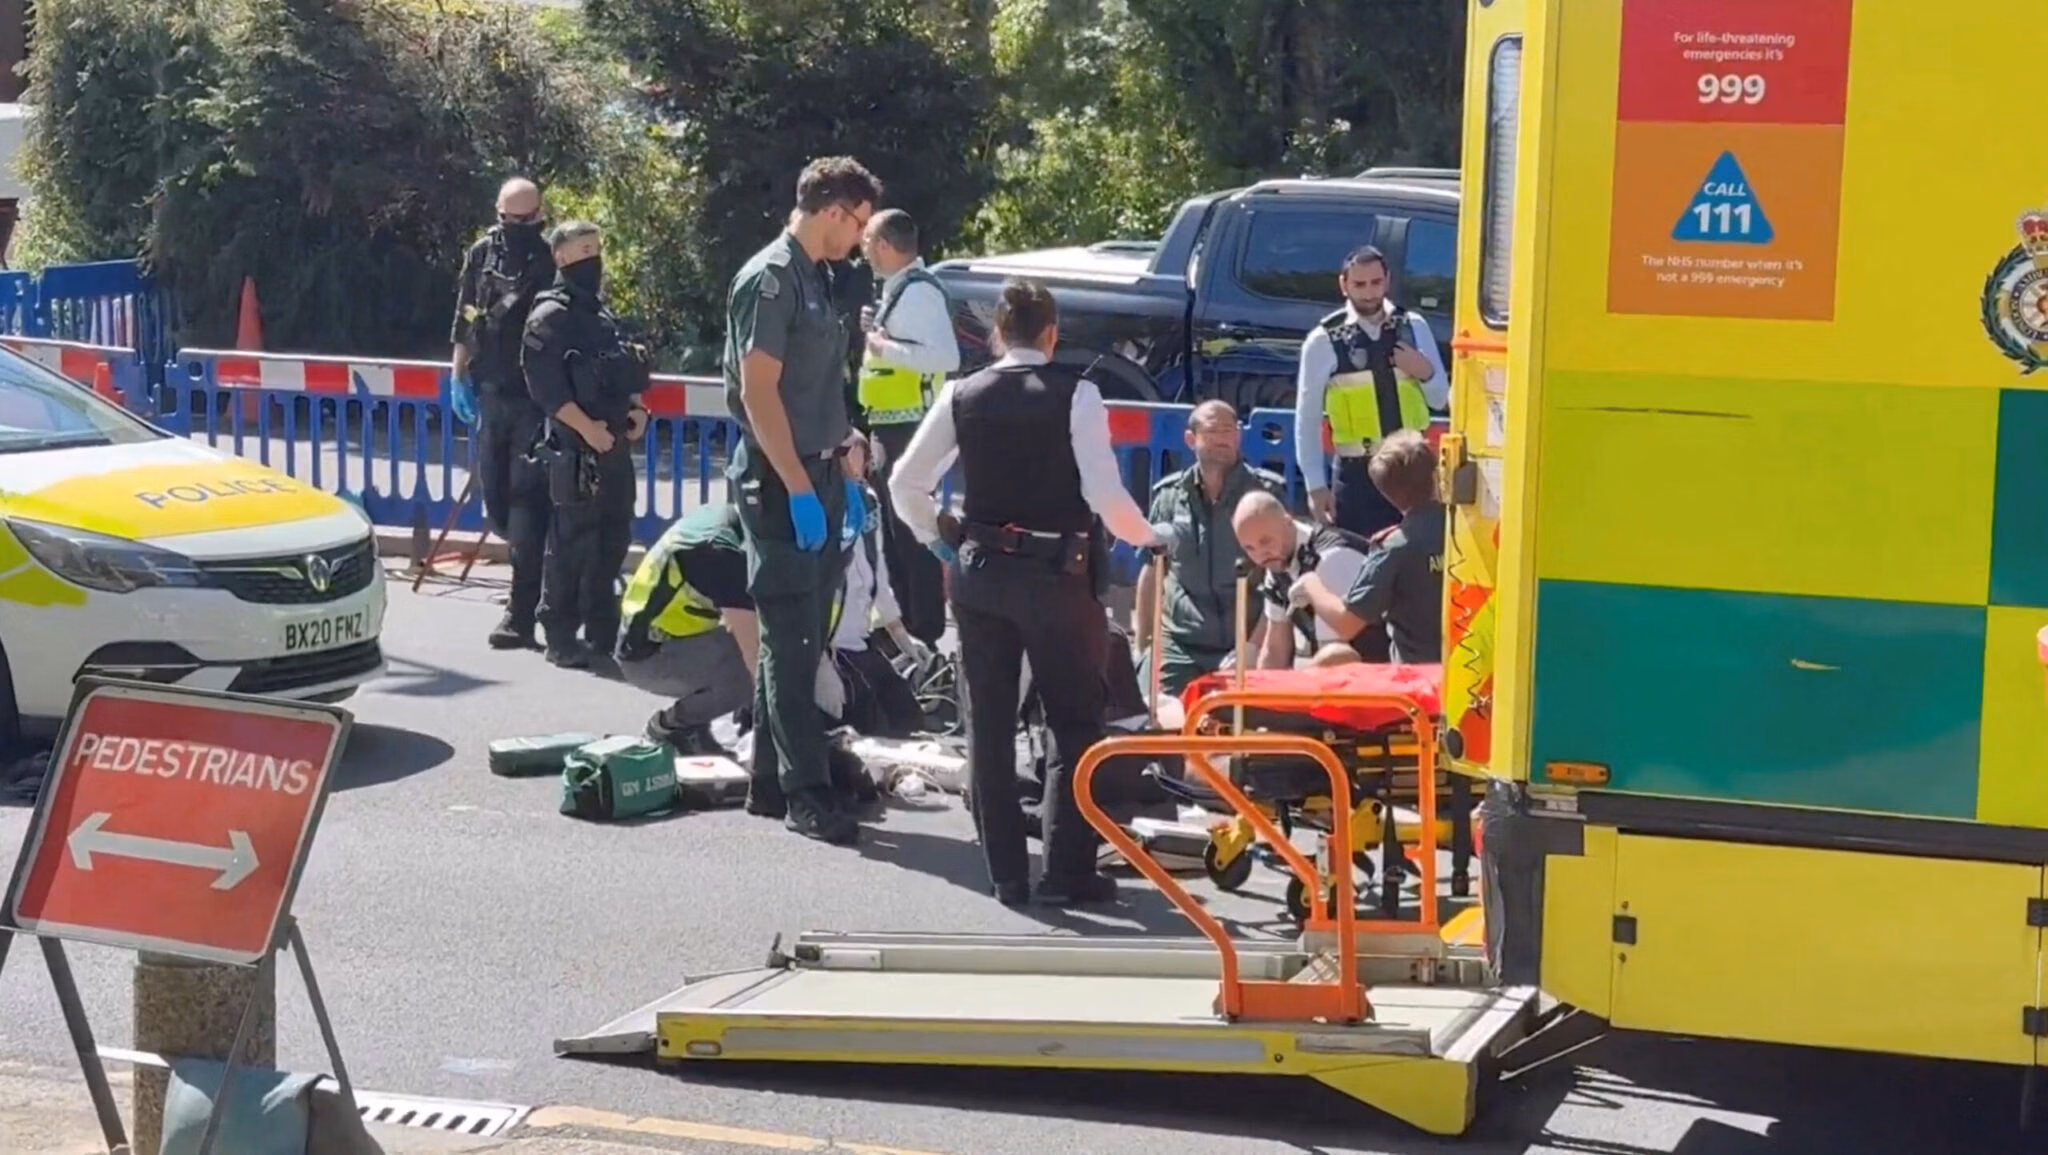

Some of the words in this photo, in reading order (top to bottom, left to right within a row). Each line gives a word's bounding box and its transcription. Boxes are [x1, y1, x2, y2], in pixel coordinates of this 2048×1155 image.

[1674, 32, 1694, 43] For
[1697, 31, 1796, 48] life-threatening
[1683, 49, 1762, 62] emergencies
[1765, 48, 1784, 61] it's
[1697, 73, 1766, 104] 999
[1703, 181, 1747, 197] CALL
[1694, 202, 1752, 234] 111
[1642, 255, 1664, 266] The
[1667, 255, 1693, 268] NHS
[1696, 257, 1745, 270] number
[1747, 259, 1783, 271] when
[1785, 259, 1803, 271] it's
[1656, 272, 1678, 283] not
[1680, 274, 1689, 283] a
[1691, 272, 1714, 284] 999
[1716, 275, 1785, 288] emergency
[134, 477, 298, 509] POLICE
[286, 618, 331, 650] BX20
[73, 732, 313, 796] PEDESTRIANS
